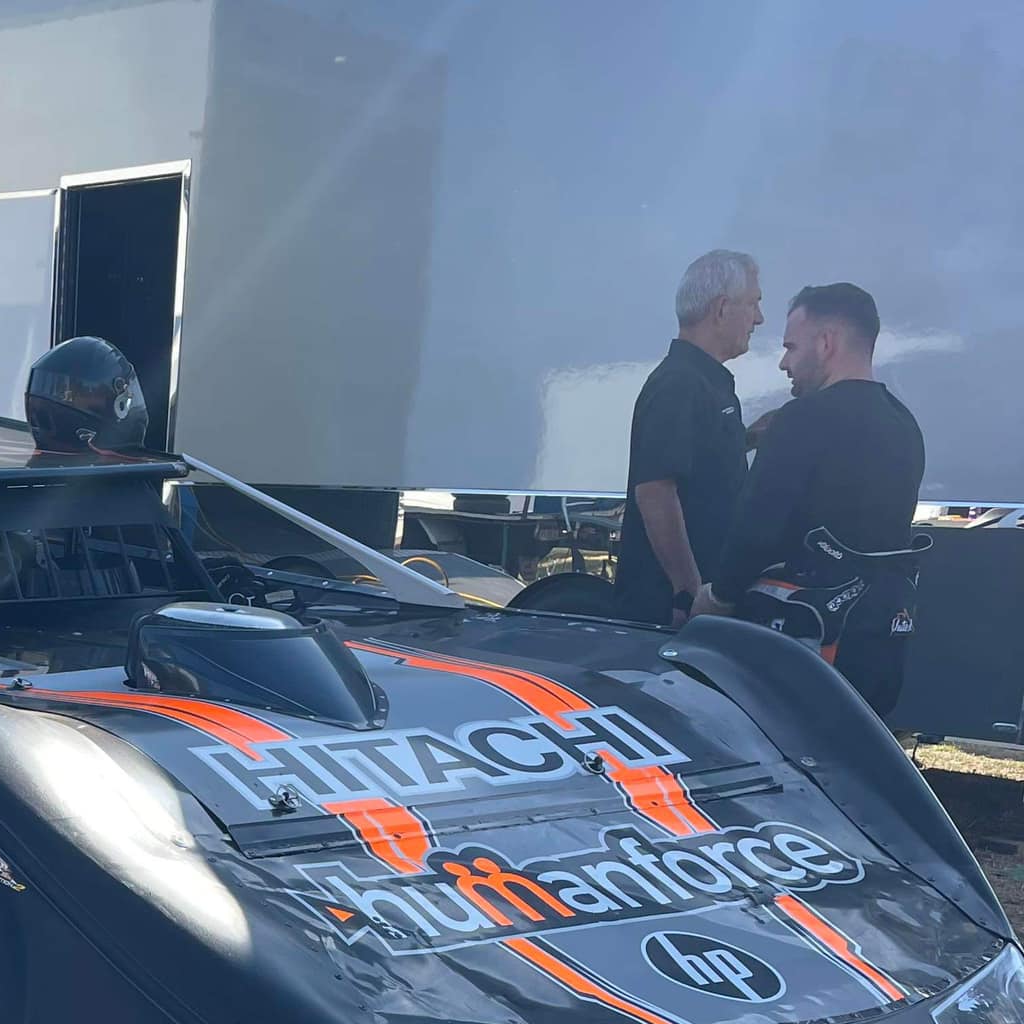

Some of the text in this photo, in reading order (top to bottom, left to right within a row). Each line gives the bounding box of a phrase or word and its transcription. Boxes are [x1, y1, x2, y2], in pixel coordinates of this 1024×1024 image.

[192, 706, 689, 809] HITACHI
[327, 831, 845, 936] humanforce
[651, 932, 763, 1002] hp
